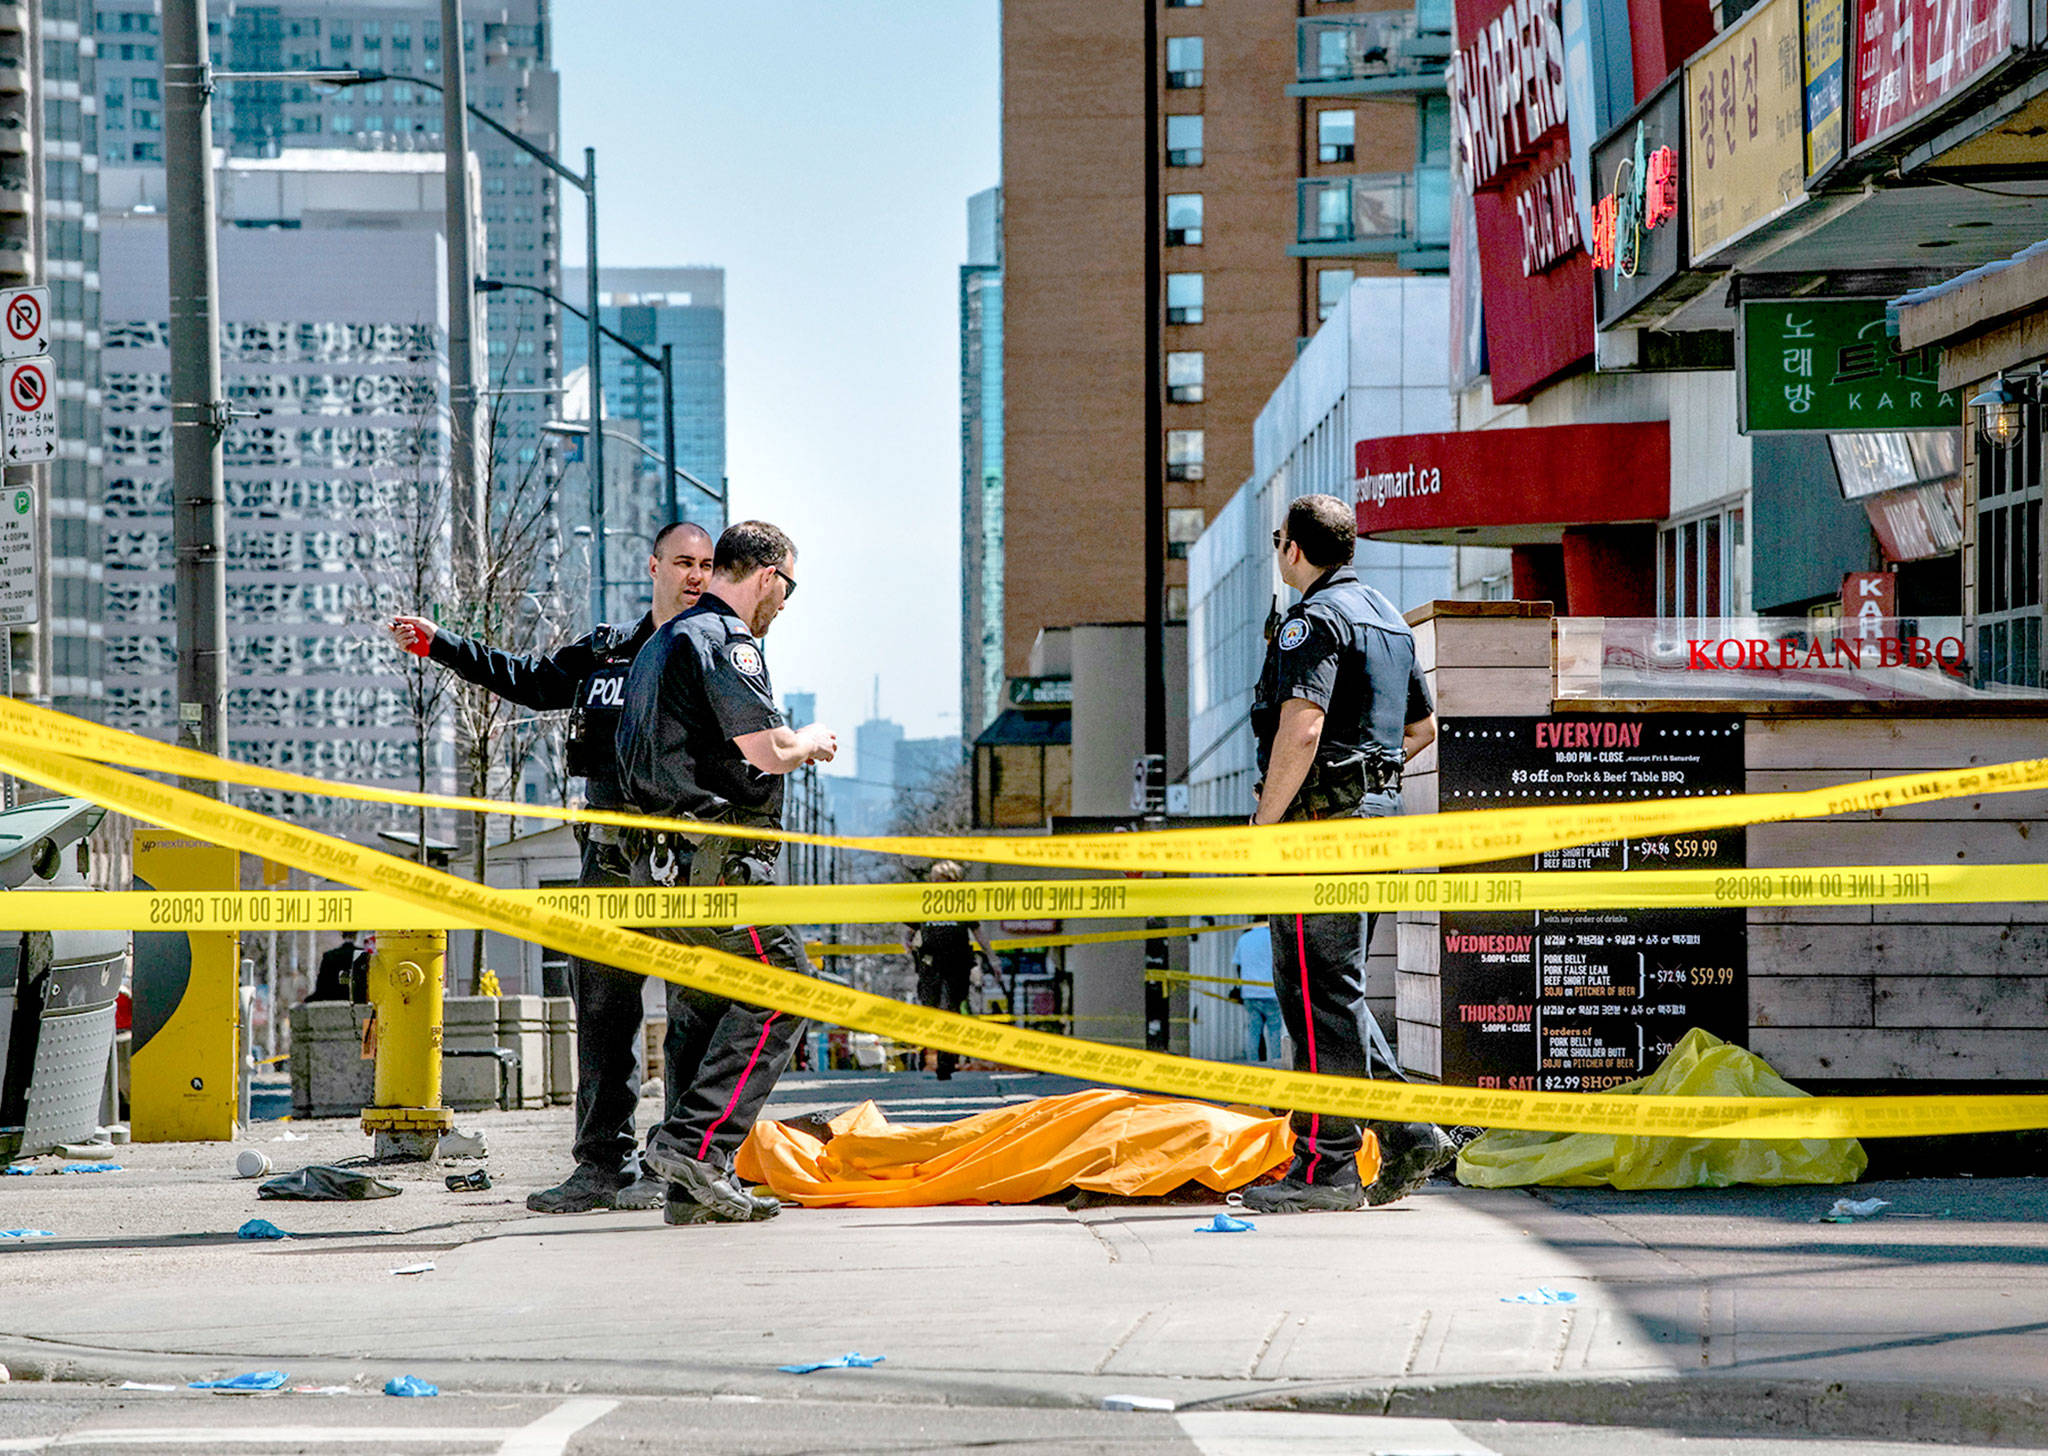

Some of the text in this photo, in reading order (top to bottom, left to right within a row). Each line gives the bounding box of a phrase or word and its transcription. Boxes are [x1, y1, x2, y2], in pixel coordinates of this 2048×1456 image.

[1444, 0, 1567, 197] SHOPPERS
[1782, 313, 1816, 414] 노래방
[8, 413, 12, 425] 7
[35, 411, 40, 422] 9
[1686, 636, 1966, 677] KOREAN BBQ
[1536, 722, 1643, 748] EVERYDAY
[1555, 752, 1577, 762] 10:00
[1579, 752, 1591, 762] PM
[1600, 752, 1623, 762] CLOSE
[1512, 769, 1684, 783] $3 off on Pork & Beef Table BBQ
[1562, 848, 1584, 857] SHORT
[1587, 848, 1610, 858] PLATE
[1675, 839, 1717, 858] $59.99
[1543, 859, 1591, 868] BEEF RIB EYE
[1605, 915, 1627, 923] drinks
[1445, 935, 1532, 953] WEDNESDAY
[1544, 955, 1586, 963] PORK BELLY
[1544, 965, 1608, 974] PORK FALSE LEAN
[1544, 976, 1610, 985] BEEF SHORT PLATE
[1691, 968, 1733, 985] $59.99
[1544, 987, 1563, 996] SOJU
[1575, 987, 1605, 996] PITCHER
[1608, 987, 1616, 995] OF
[1618, 987, 1635, 995] BEER
[1459, 1005, 1532, 1022] THURSDAY
[1512, 1024, 1531, 1032] CLOSE
[1543, 1027, 1592, 1036] 3 orders of
[1550, 1038, 1568, 1046] PORK
[1570, 1038, 1592, 1046] BELLY
[1550, 1048, 1626, 1057] PORK SHOULDER BUTT
[1543, 1059, 1561, 1068] SOJU
[1573, 1059, 1604, 1068] PITCHER
[1606, 1059, 1614, 1068] OF
[1616, 1059, 1634, 1068] BEER
[1478, 1076, 1534, 1090] FRI SAT
[1545, 1076, 1579, 1090] $2.99
[1582, 1076, 1622, 1089] SHOT
